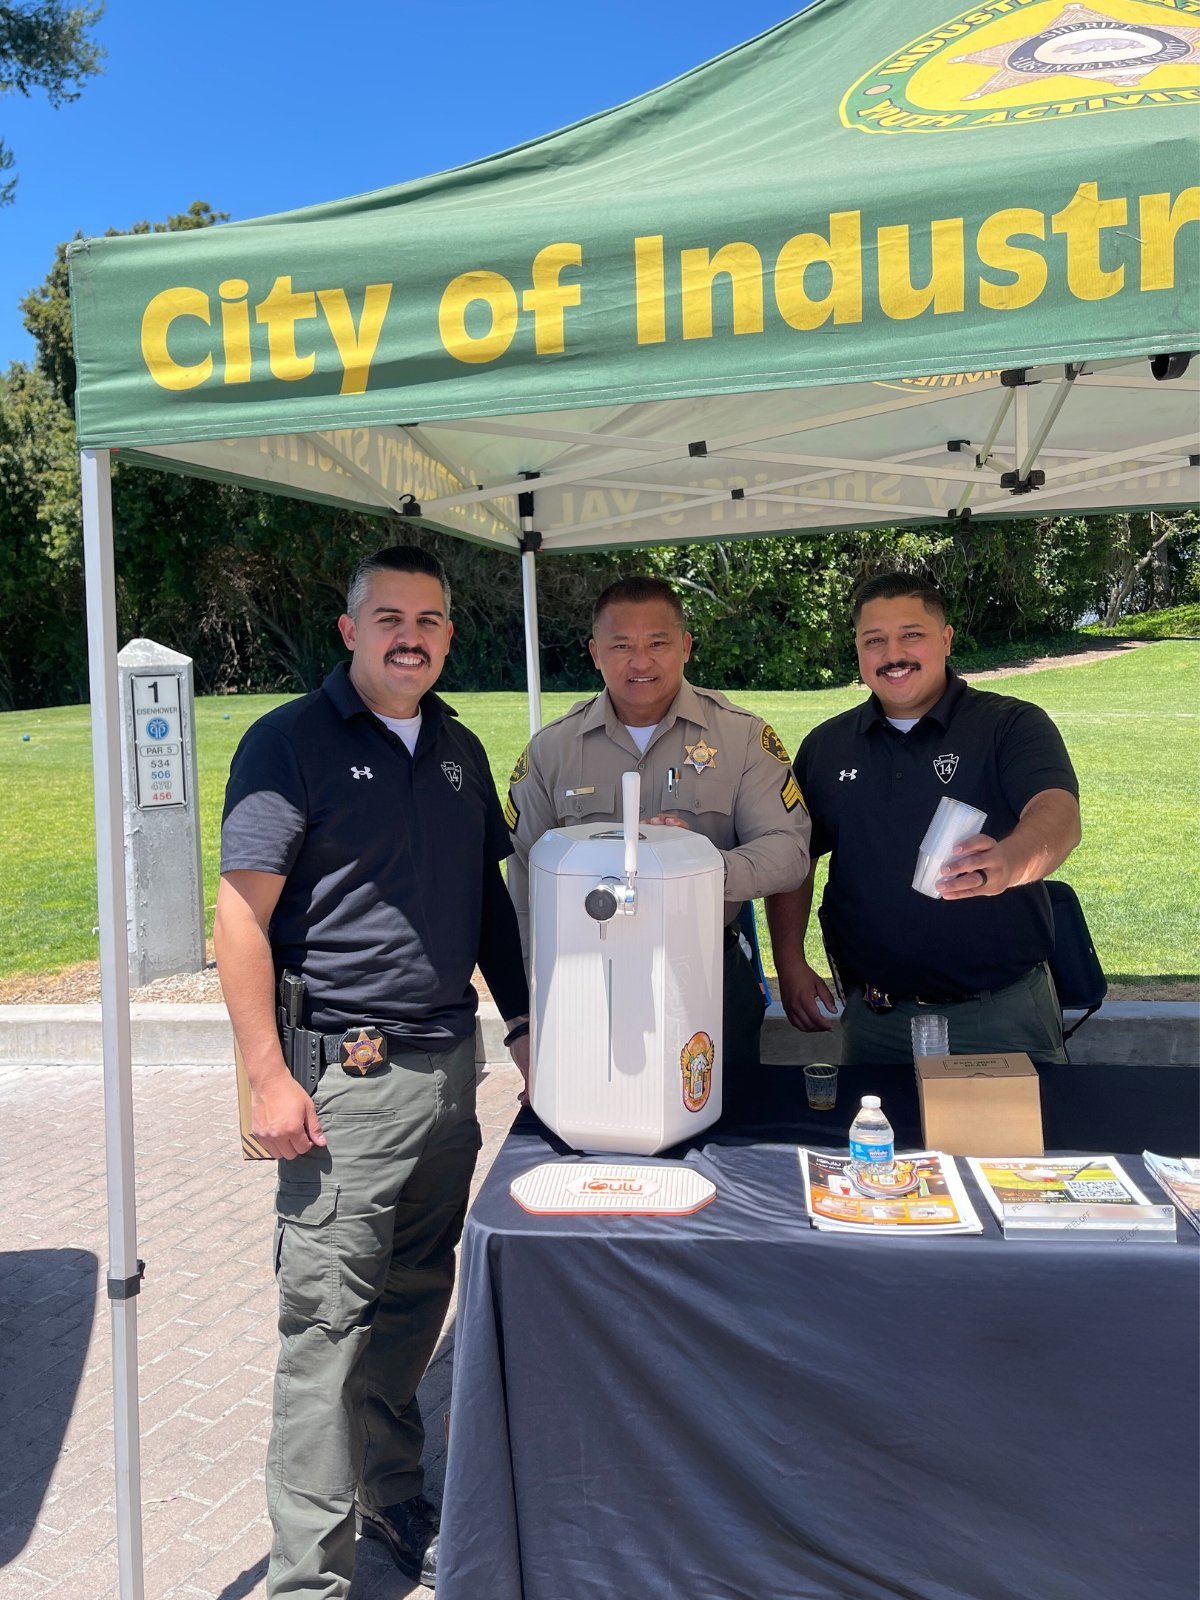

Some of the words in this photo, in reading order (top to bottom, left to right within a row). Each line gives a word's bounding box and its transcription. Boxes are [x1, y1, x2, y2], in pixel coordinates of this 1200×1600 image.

[1040, 21, 1138, 40] SHERIFF
[1037, 60, 1141, 74] ANGELES
[858, 98, 969, 129] YOUTH
[141, 275, 393, 394] City
[438, 243, 581, 364] of
[148, 681, 159, 703] 1
[136, 706, 178, 716] EISENHOWER
[146, 747, 164, 756] PAR
[166, 746, 173, 755] 5
[150, 759, 170, 768] 534
[940, 763, 952, 775] 14
[151, 770, 171, 779] 506
[447, 770, 459, 782] 14
[152, 791, 172, 801] 456
